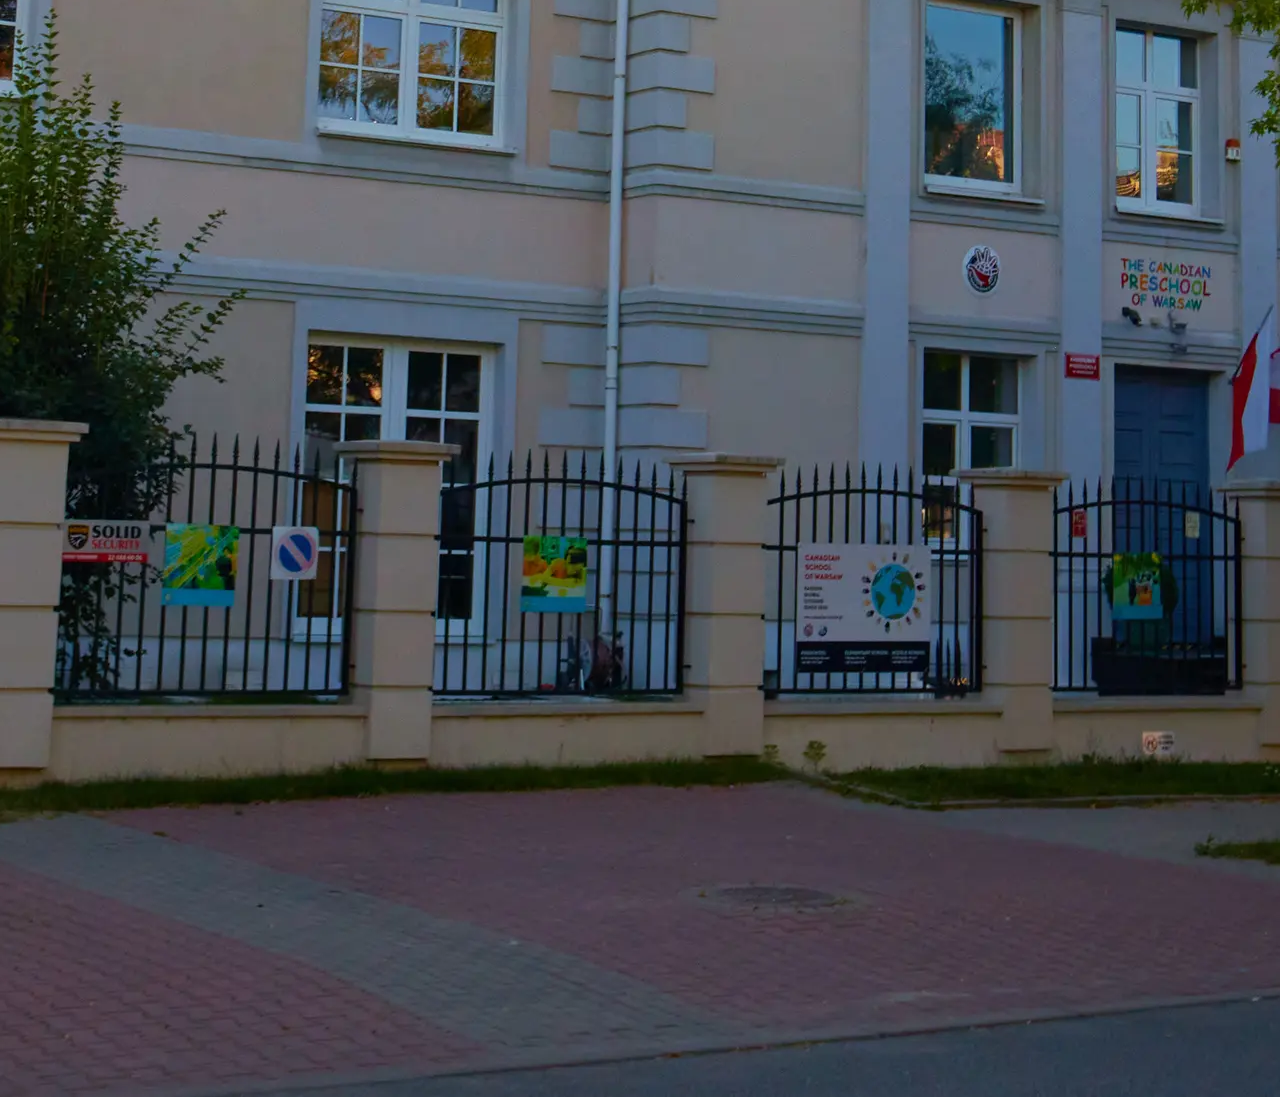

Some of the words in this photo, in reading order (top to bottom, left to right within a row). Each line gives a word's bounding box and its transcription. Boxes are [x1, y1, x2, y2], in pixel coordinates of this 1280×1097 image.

[1121, 258, 1144, 272] THE
[1149, 261, 1211, 278] CANADIAN
[1121, 272, 1211, 296] PRESCHOOL
[1131, 293, 1147, 306] OF
[1152, 295, 1202, 311] WARSAW
[92, 525, 141, 539] SOLID
[92, 538, 141, 550] SECURITY
[814, 573, 843, 581] WARSAW
